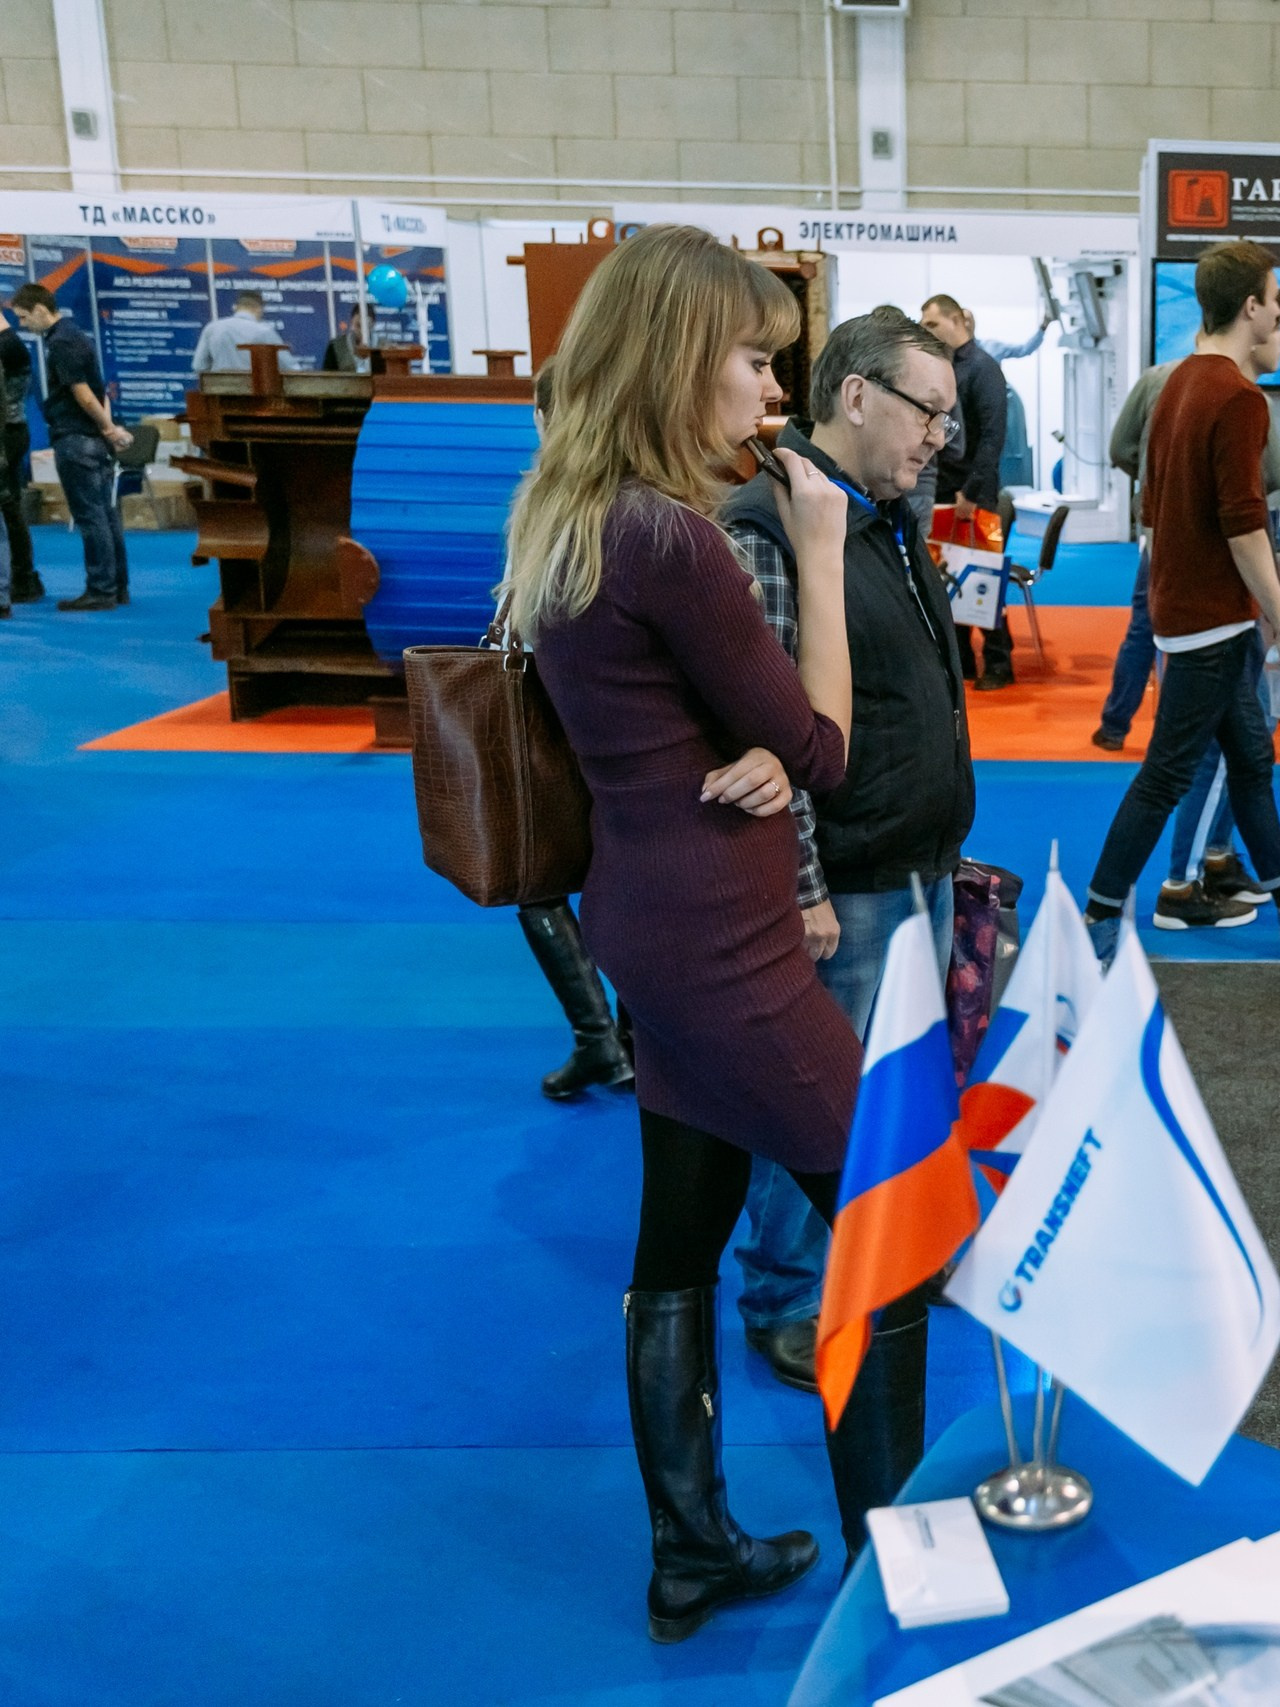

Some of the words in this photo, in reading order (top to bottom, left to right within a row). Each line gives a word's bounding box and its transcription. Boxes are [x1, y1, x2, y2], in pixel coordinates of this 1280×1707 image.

[79, 205, 107, 226] ТД
[112, 206, 216, 225] «МАССКО»
[800, 221, 958, 243] ЭЛЕКТРОМАШИНА
[1015, 1125, 1102, 1283] TRANSNEFT
